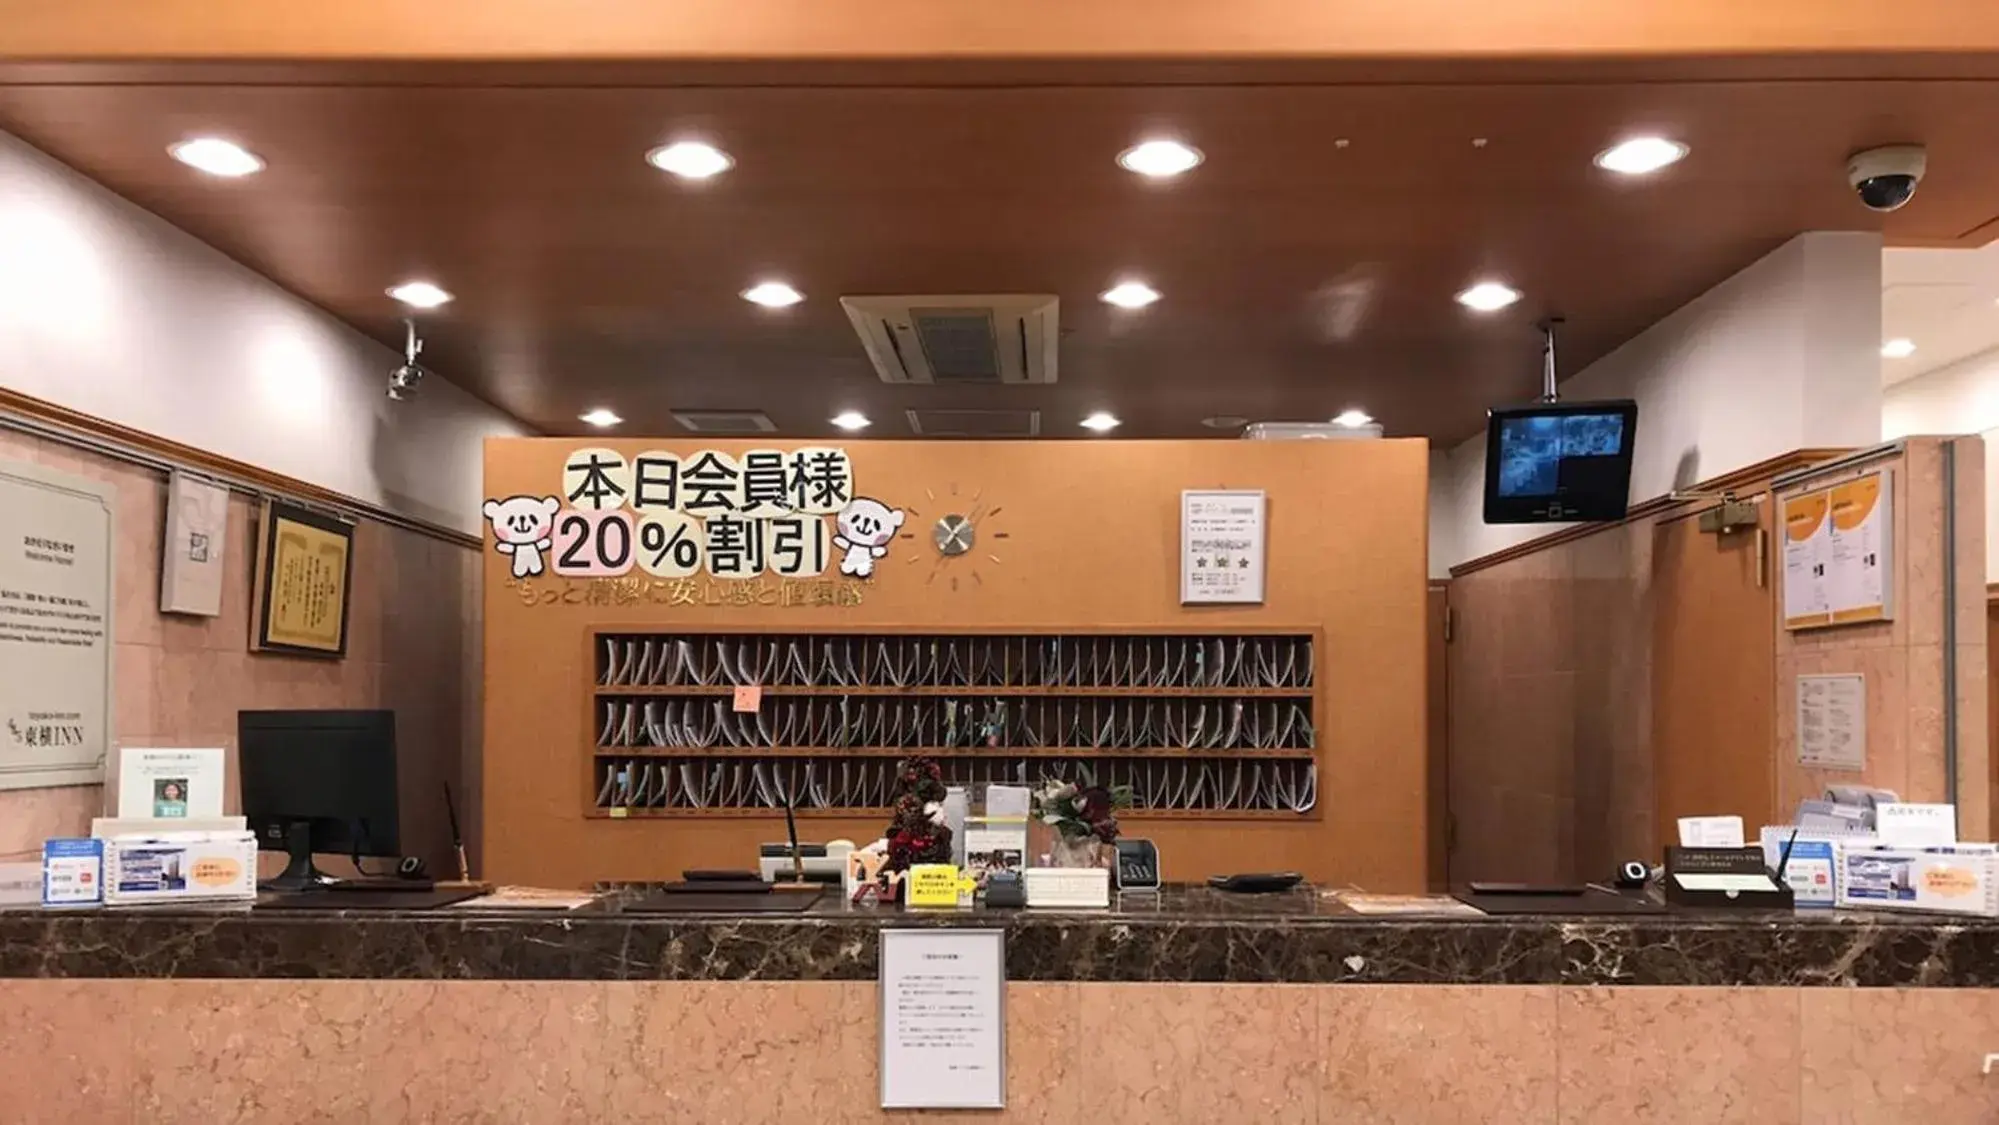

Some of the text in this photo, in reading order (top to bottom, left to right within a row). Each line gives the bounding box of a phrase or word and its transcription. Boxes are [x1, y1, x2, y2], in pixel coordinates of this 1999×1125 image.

[566, 452, 847, 510] 本日会員様
[558, 514, 823, 574] 20%割引
